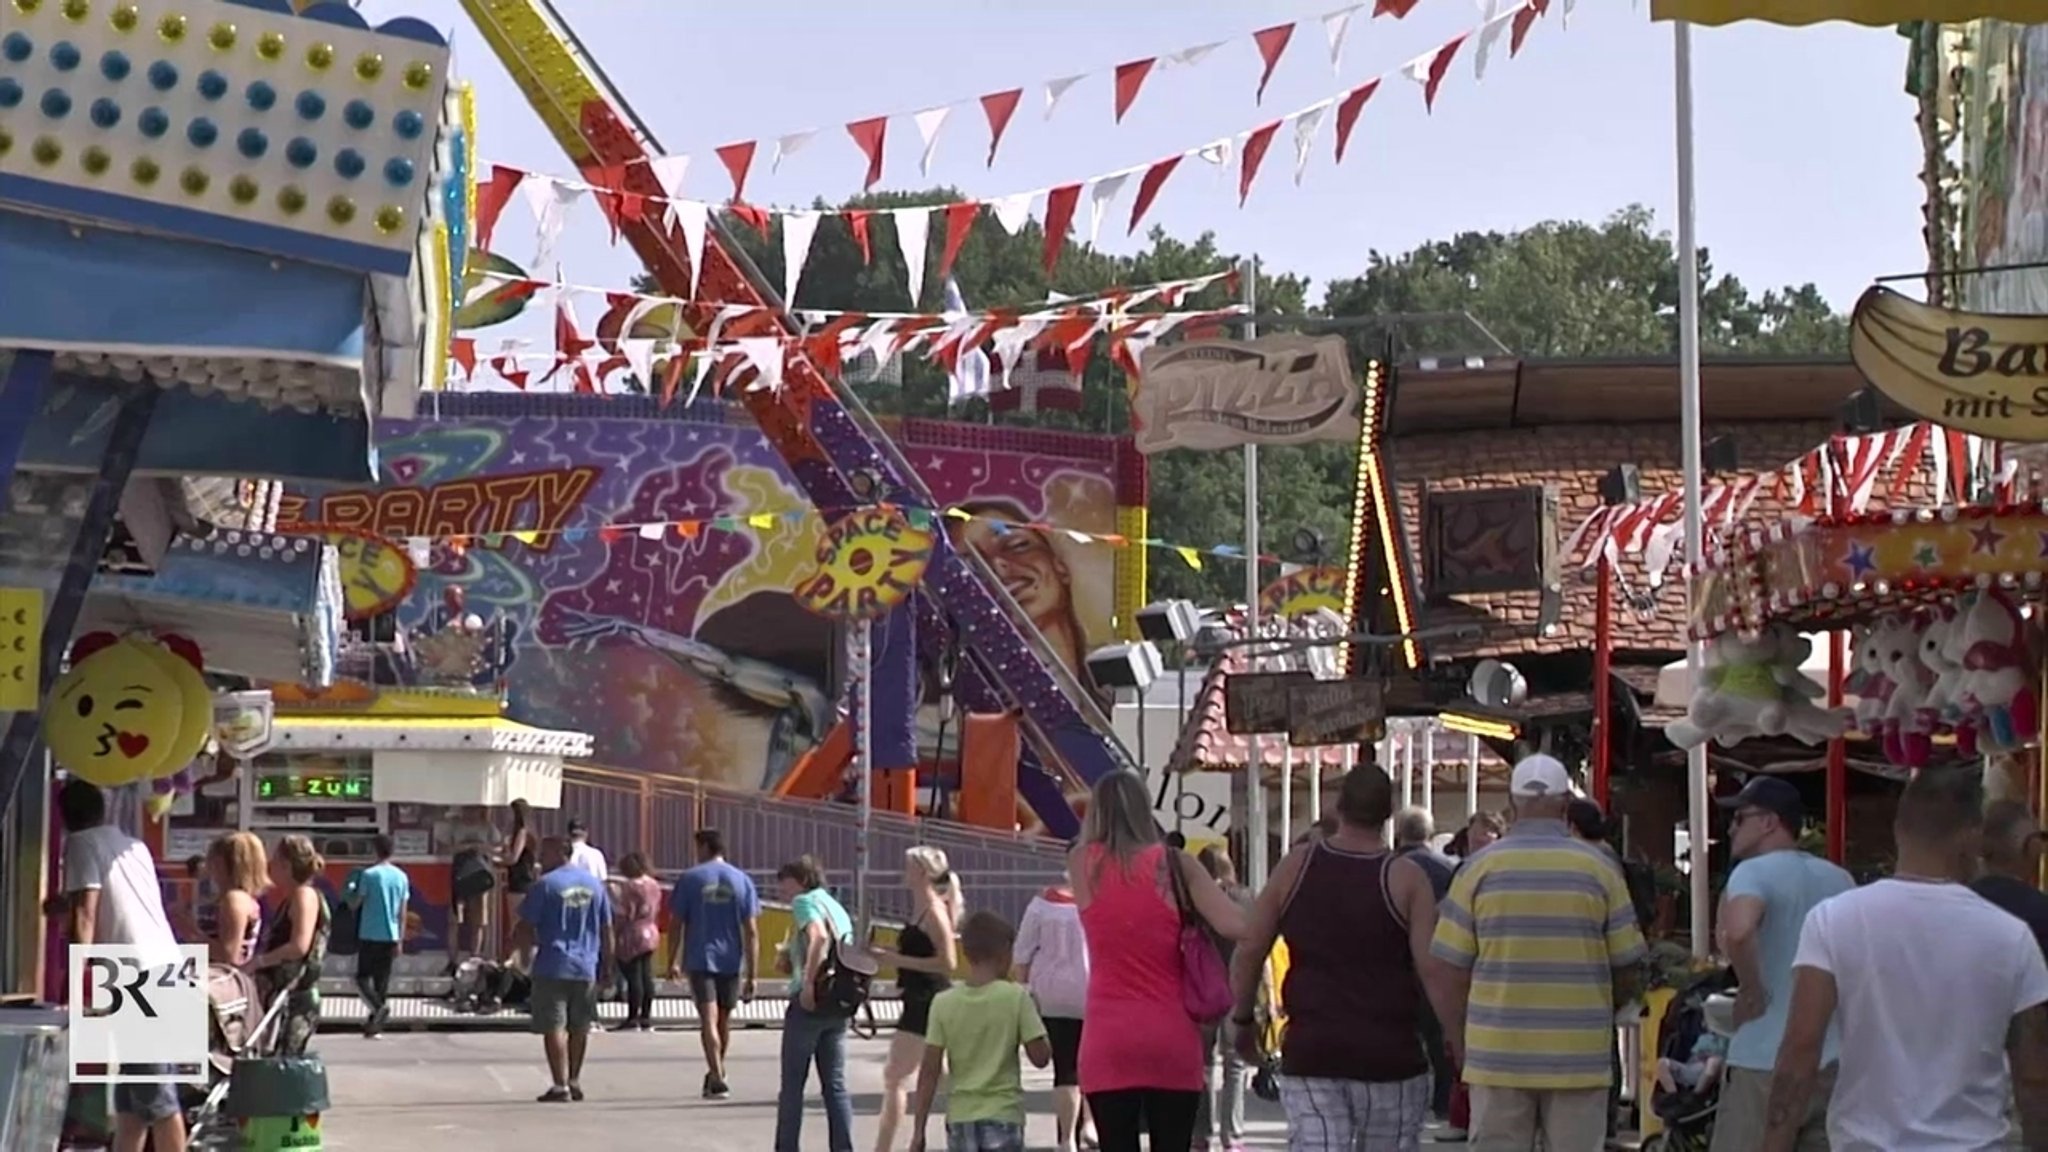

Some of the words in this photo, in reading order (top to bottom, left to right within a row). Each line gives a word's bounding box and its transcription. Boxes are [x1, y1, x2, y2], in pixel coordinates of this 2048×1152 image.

[1938, 326, 2048, 378] Ba
[1144, 342, 1352, 443] PIZZA
[1943, 390, 2012, 418] mit
[322, 467, 593, 549] PARTY
[815, 512, 902, 566] SPACE
[801, 548, 932, 616] PARTY
